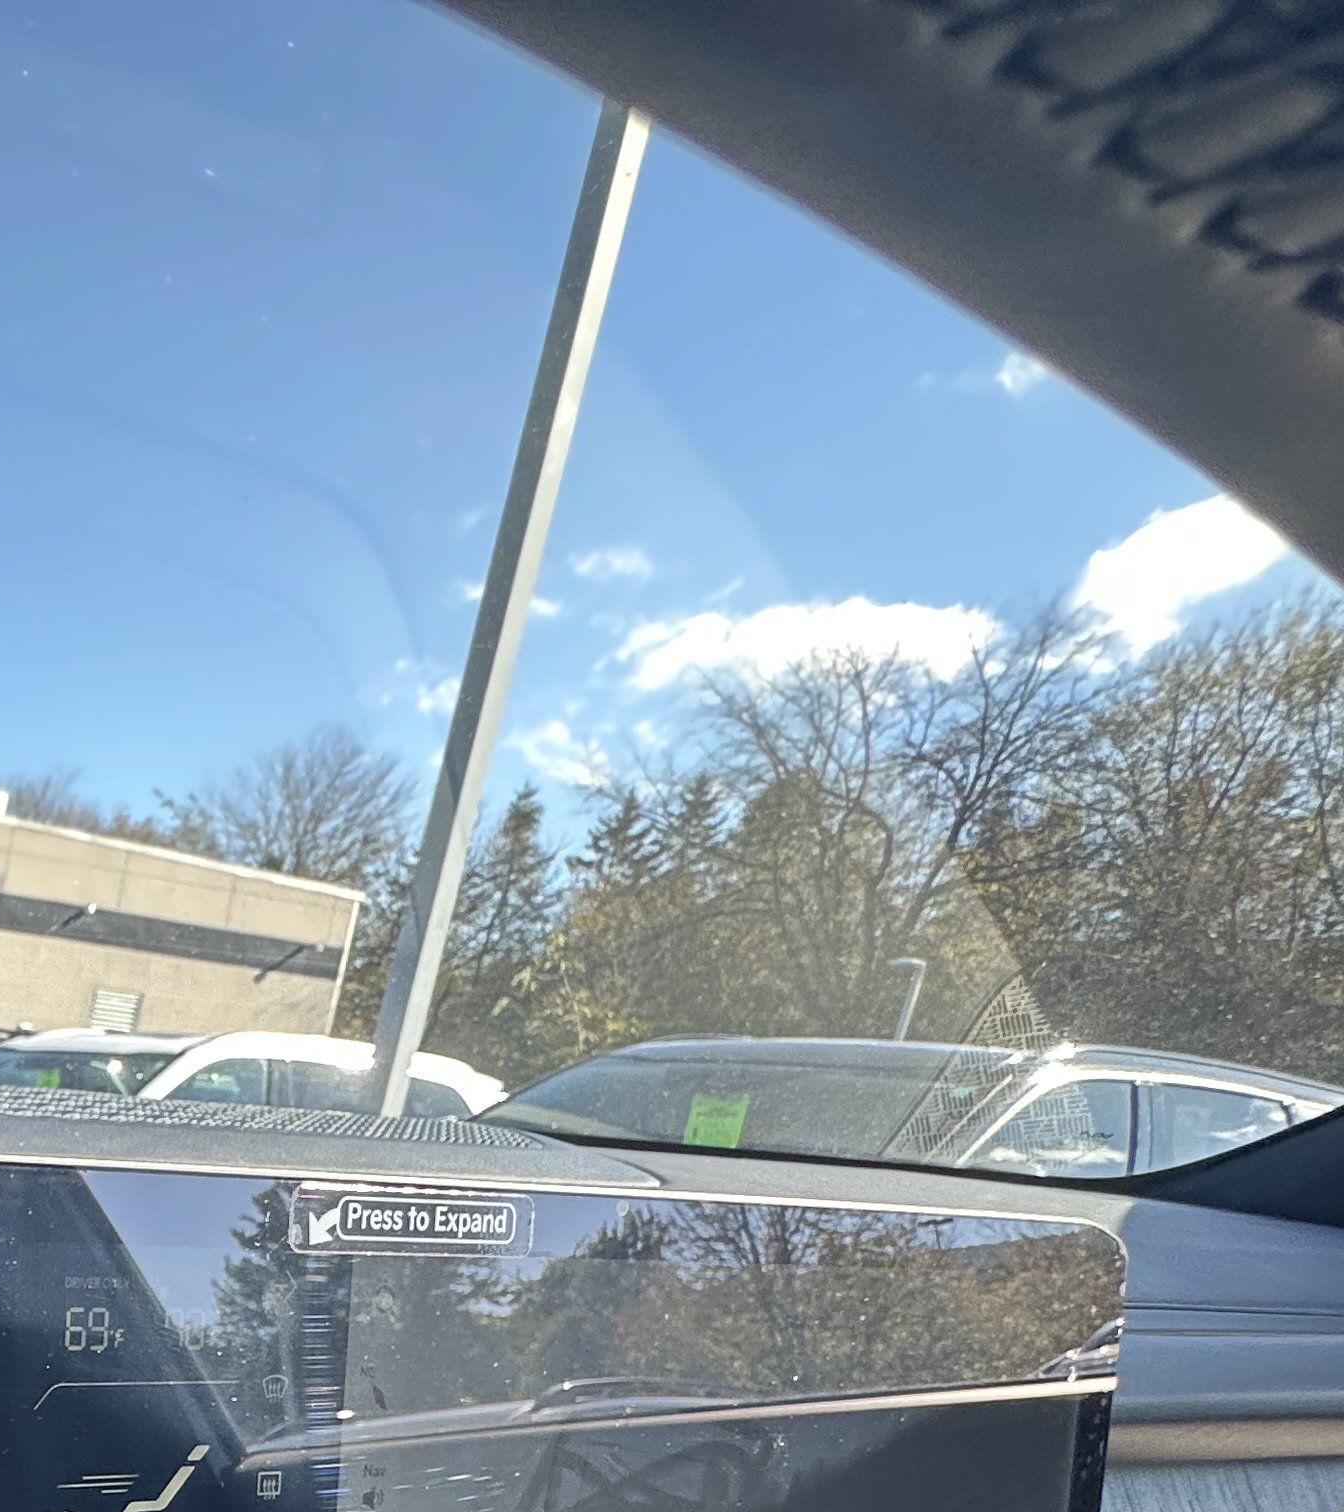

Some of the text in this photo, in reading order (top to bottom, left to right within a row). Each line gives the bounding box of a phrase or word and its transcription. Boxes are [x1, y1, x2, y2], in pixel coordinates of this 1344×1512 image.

[345, 1202, 508, 1237] Press to Expand
